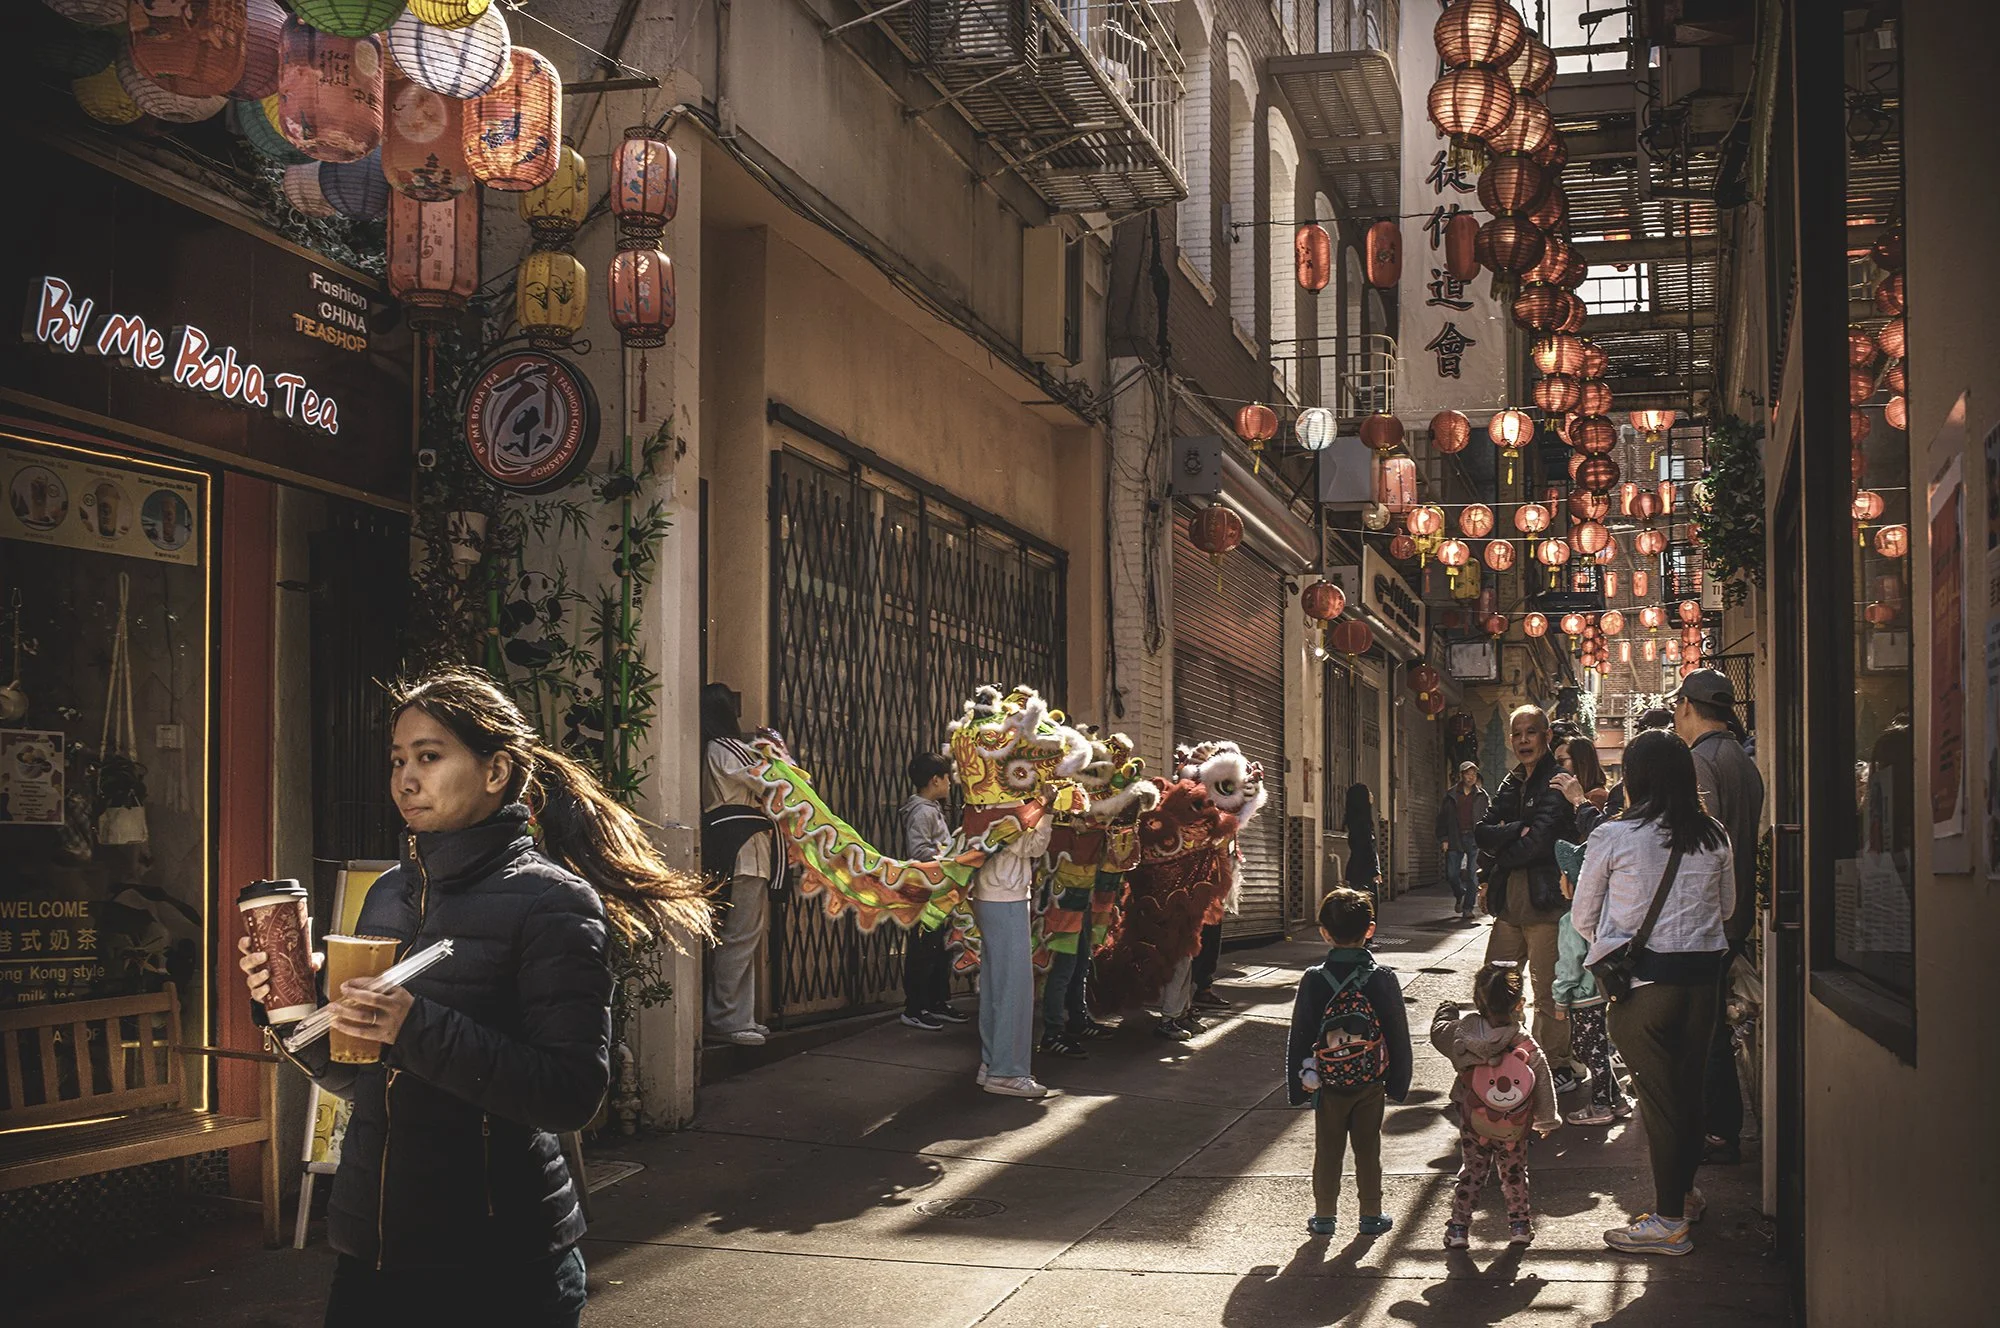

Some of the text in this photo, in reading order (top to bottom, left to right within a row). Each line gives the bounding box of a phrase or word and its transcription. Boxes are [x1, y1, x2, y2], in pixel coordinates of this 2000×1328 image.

[312, 272, 367, 309] Fashion
[293, 313, 367, 352] TEASHOP
[320, 302, 367, 333] CHINA
[98, 314, 164, 369] Me
[174, 325, 267, 407] Boba
[275, 373, 339, 434] Tea
[471, 373, 500, 454] BY ME BOBA TEA
[531, 376, 580, 477] FASHION CHINA TEASHOP
[0, 901, 89, 918] WELCOME
[30, 966, 66, 982] Kong
[73, 964, 105, 981] style
[18, 989, 47, 1002] milk
